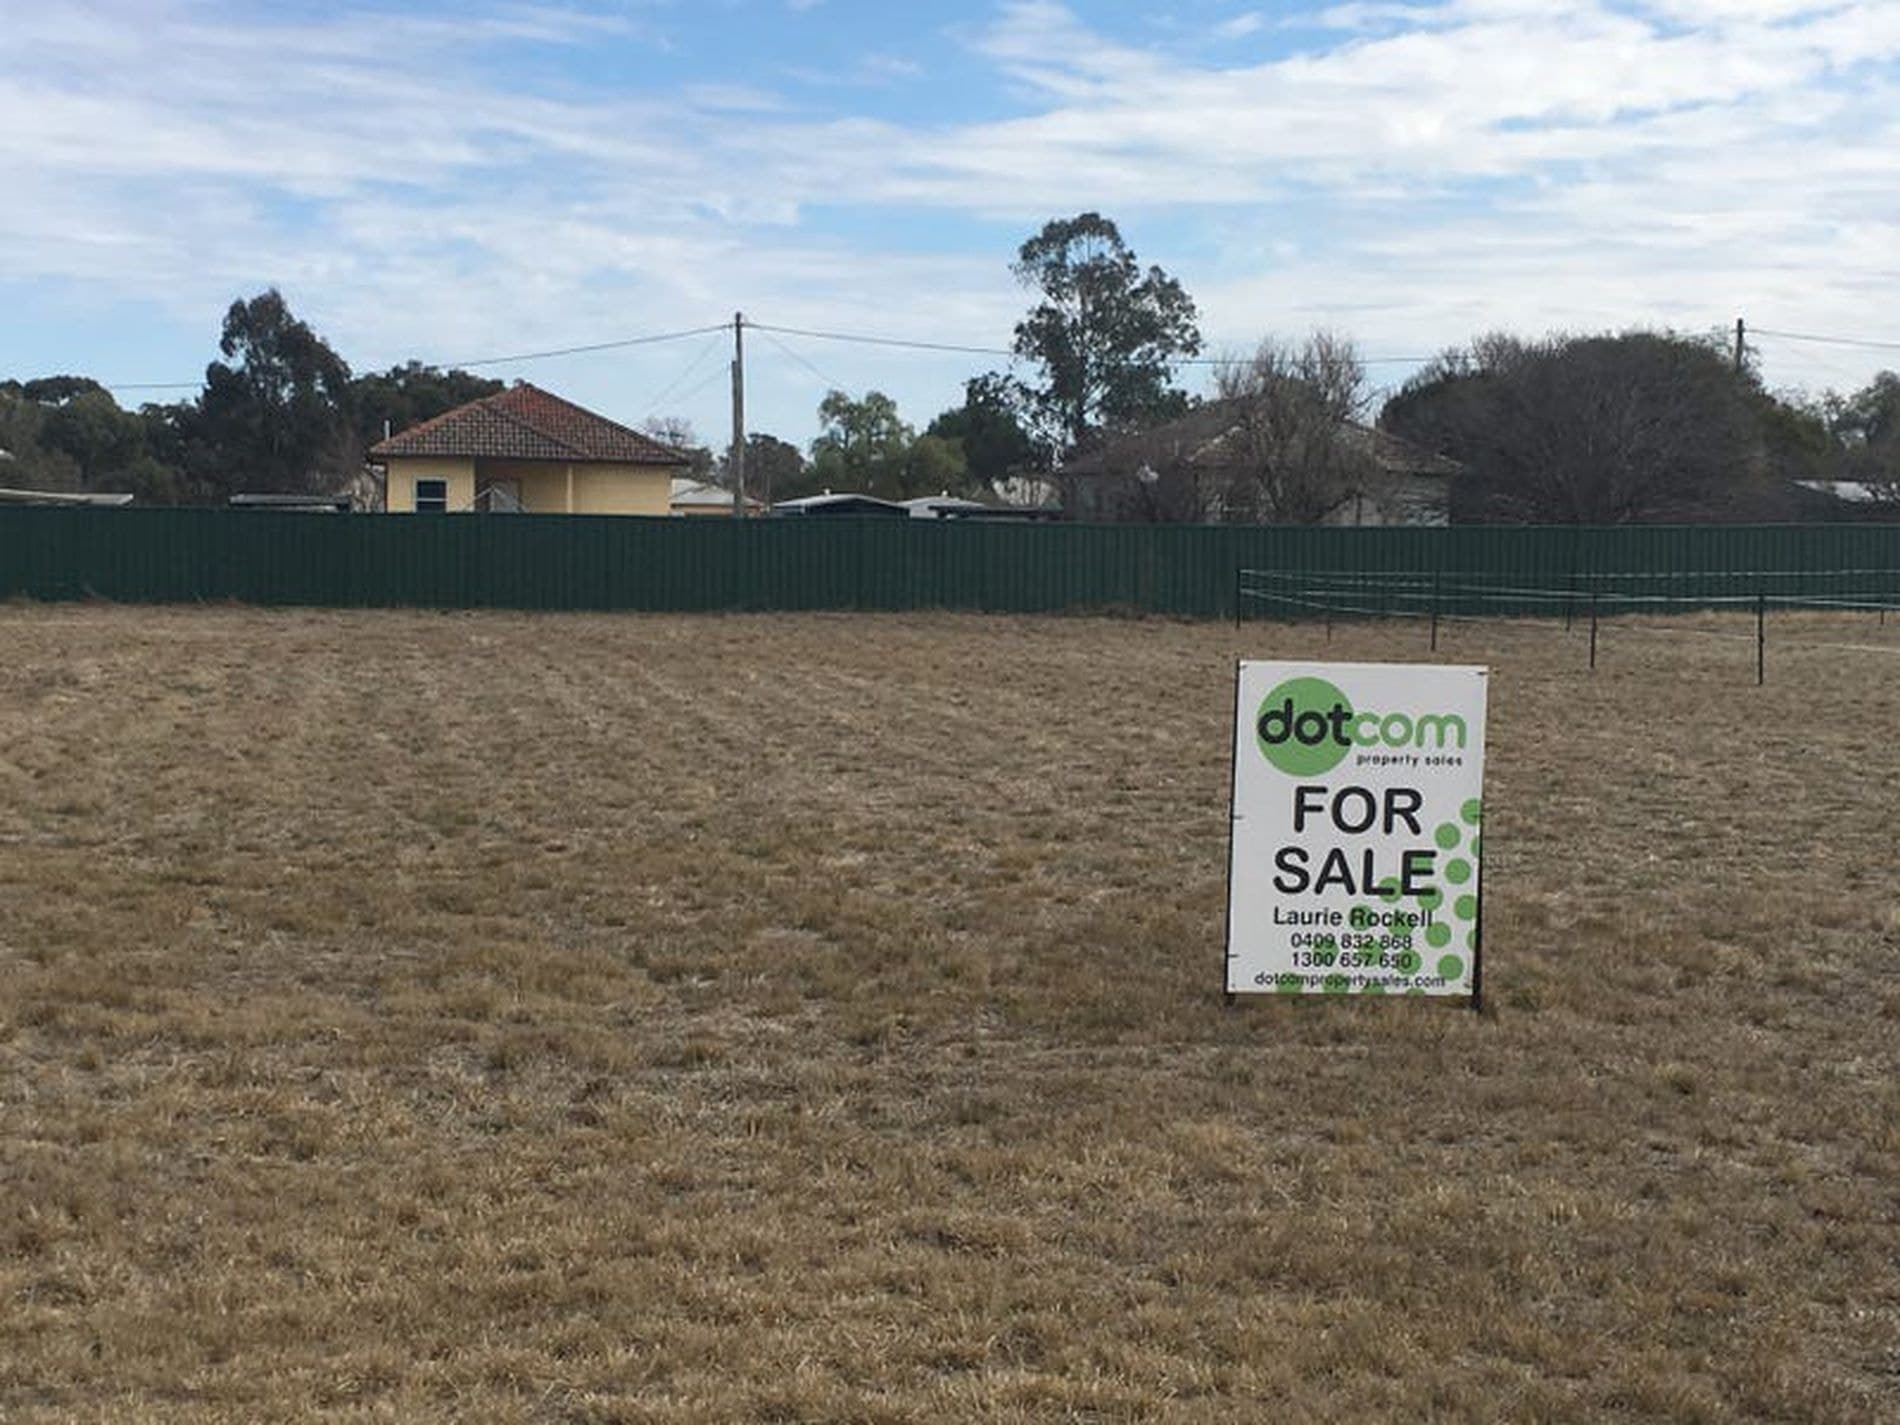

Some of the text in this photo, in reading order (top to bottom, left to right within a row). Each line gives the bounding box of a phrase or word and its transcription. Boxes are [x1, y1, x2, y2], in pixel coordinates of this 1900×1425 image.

[1257, 697, 1467, 749] dotcom
[1356, 754, 1463, 767] property sales
[1294, 785, 1423, 836] FOR
[1272, 846, 1437, 896] SALE
[1273, 906, 1433, 928] Laurie Rockell
[1290, 932, 1336, 949] 0409
[1291, 951, 1413, 968] 1300 657 650
[1254, 971, 1446, 989] dotcompropertysales.com
